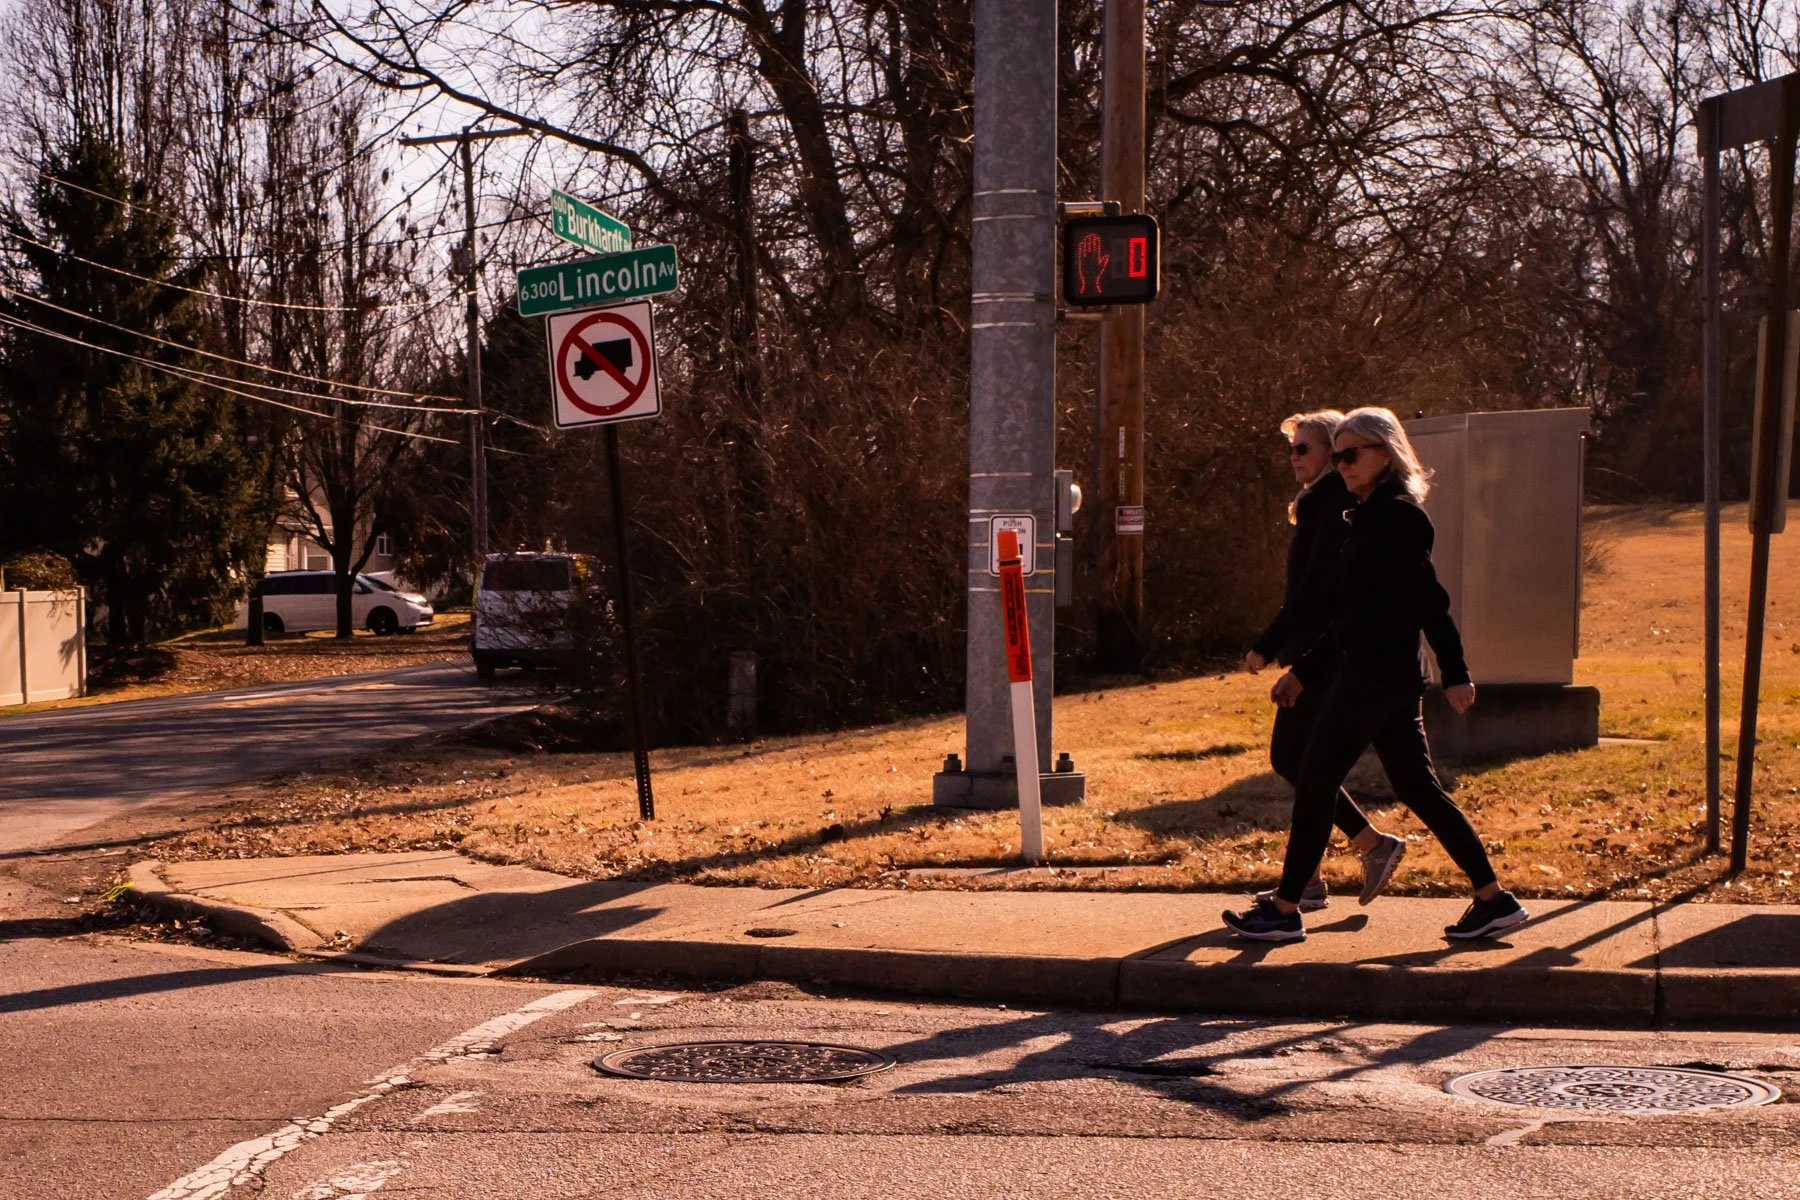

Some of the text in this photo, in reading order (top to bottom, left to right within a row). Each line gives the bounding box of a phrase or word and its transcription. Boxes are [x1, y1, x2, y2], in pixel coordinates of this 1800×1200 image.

[558, 215, 564, 232] S
[567, 203, 623, 252] Burkhardt
[1129, 237, 1147, 278] 0
[520, 259, 675, 301] 6300 Lincoln Av
